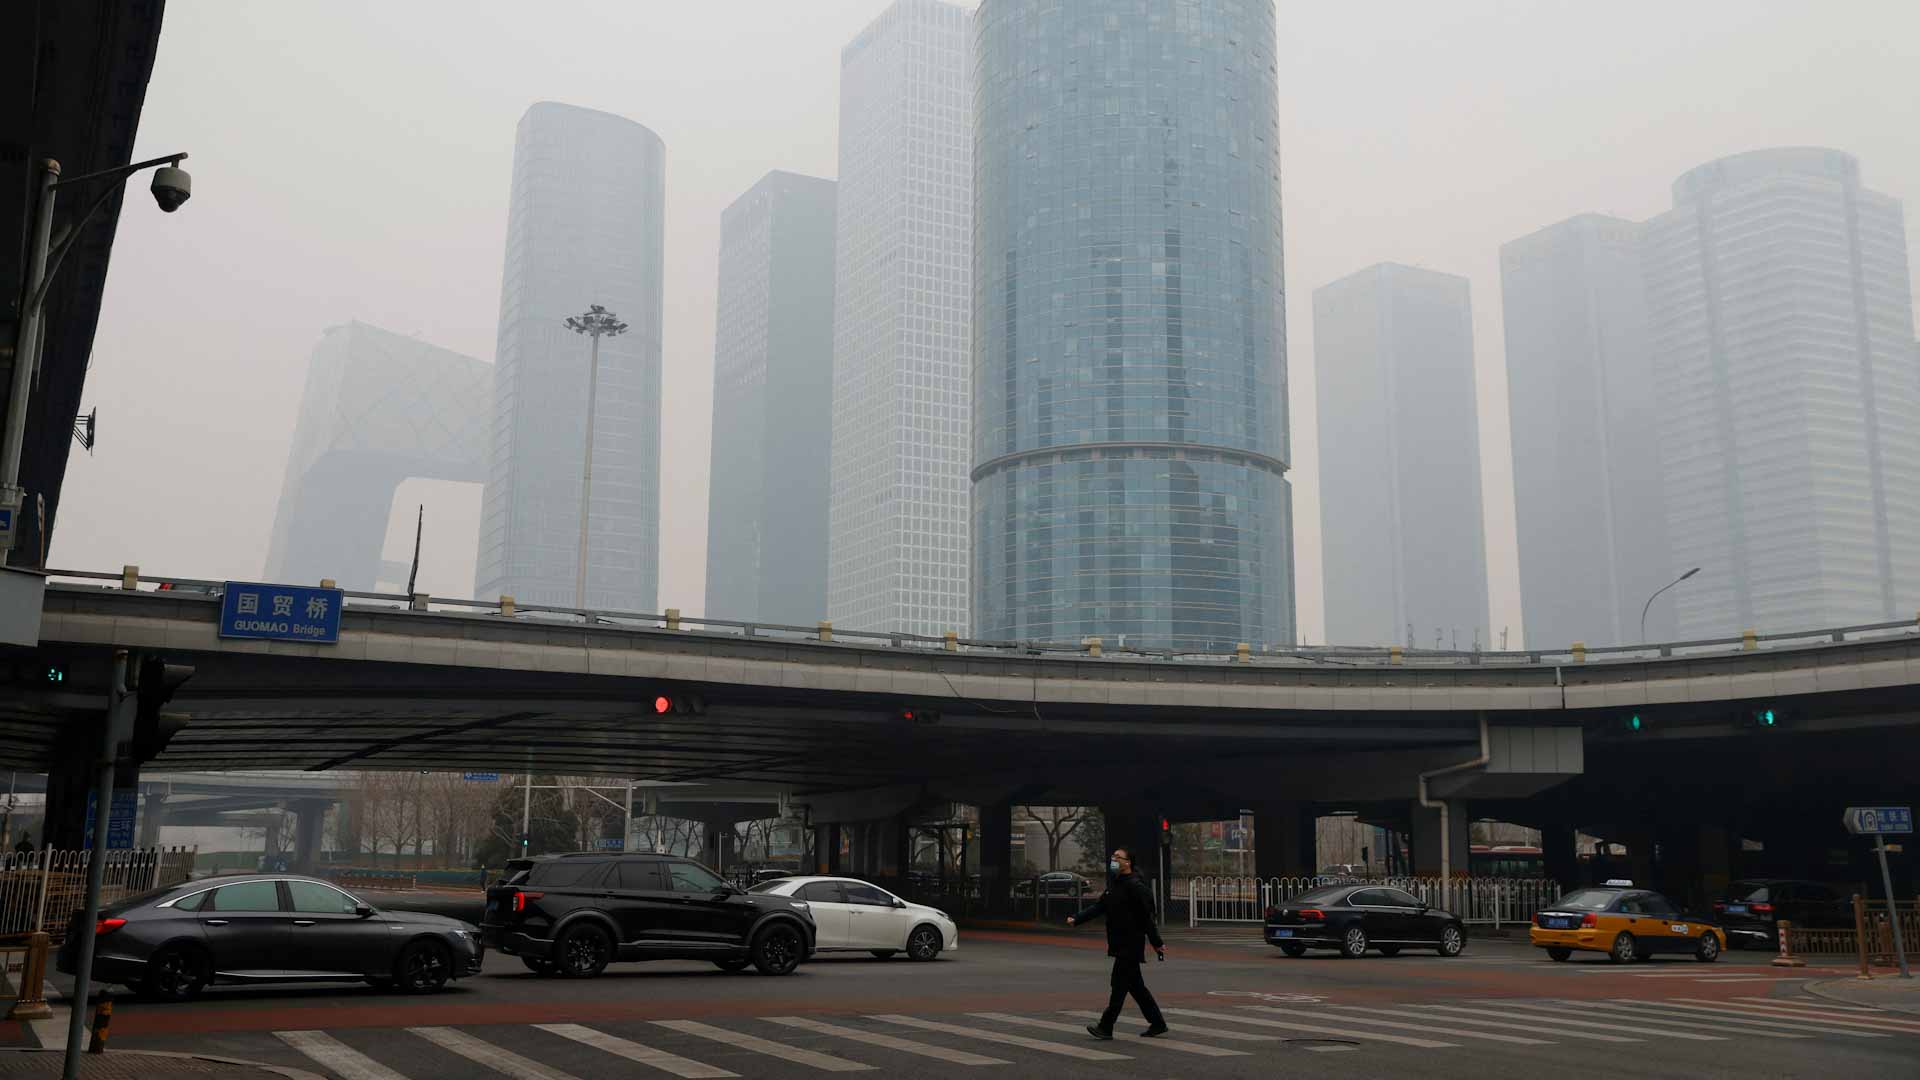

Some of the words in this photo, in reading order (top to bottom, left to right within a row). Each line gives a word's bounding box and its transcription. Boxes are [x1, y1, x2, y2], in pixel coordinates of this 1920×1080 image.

[237, 592, 329, 619] 国贸桥
[234, 620, 288, 633] GUOMAO
[293, 624, 326, 637] Bridge
